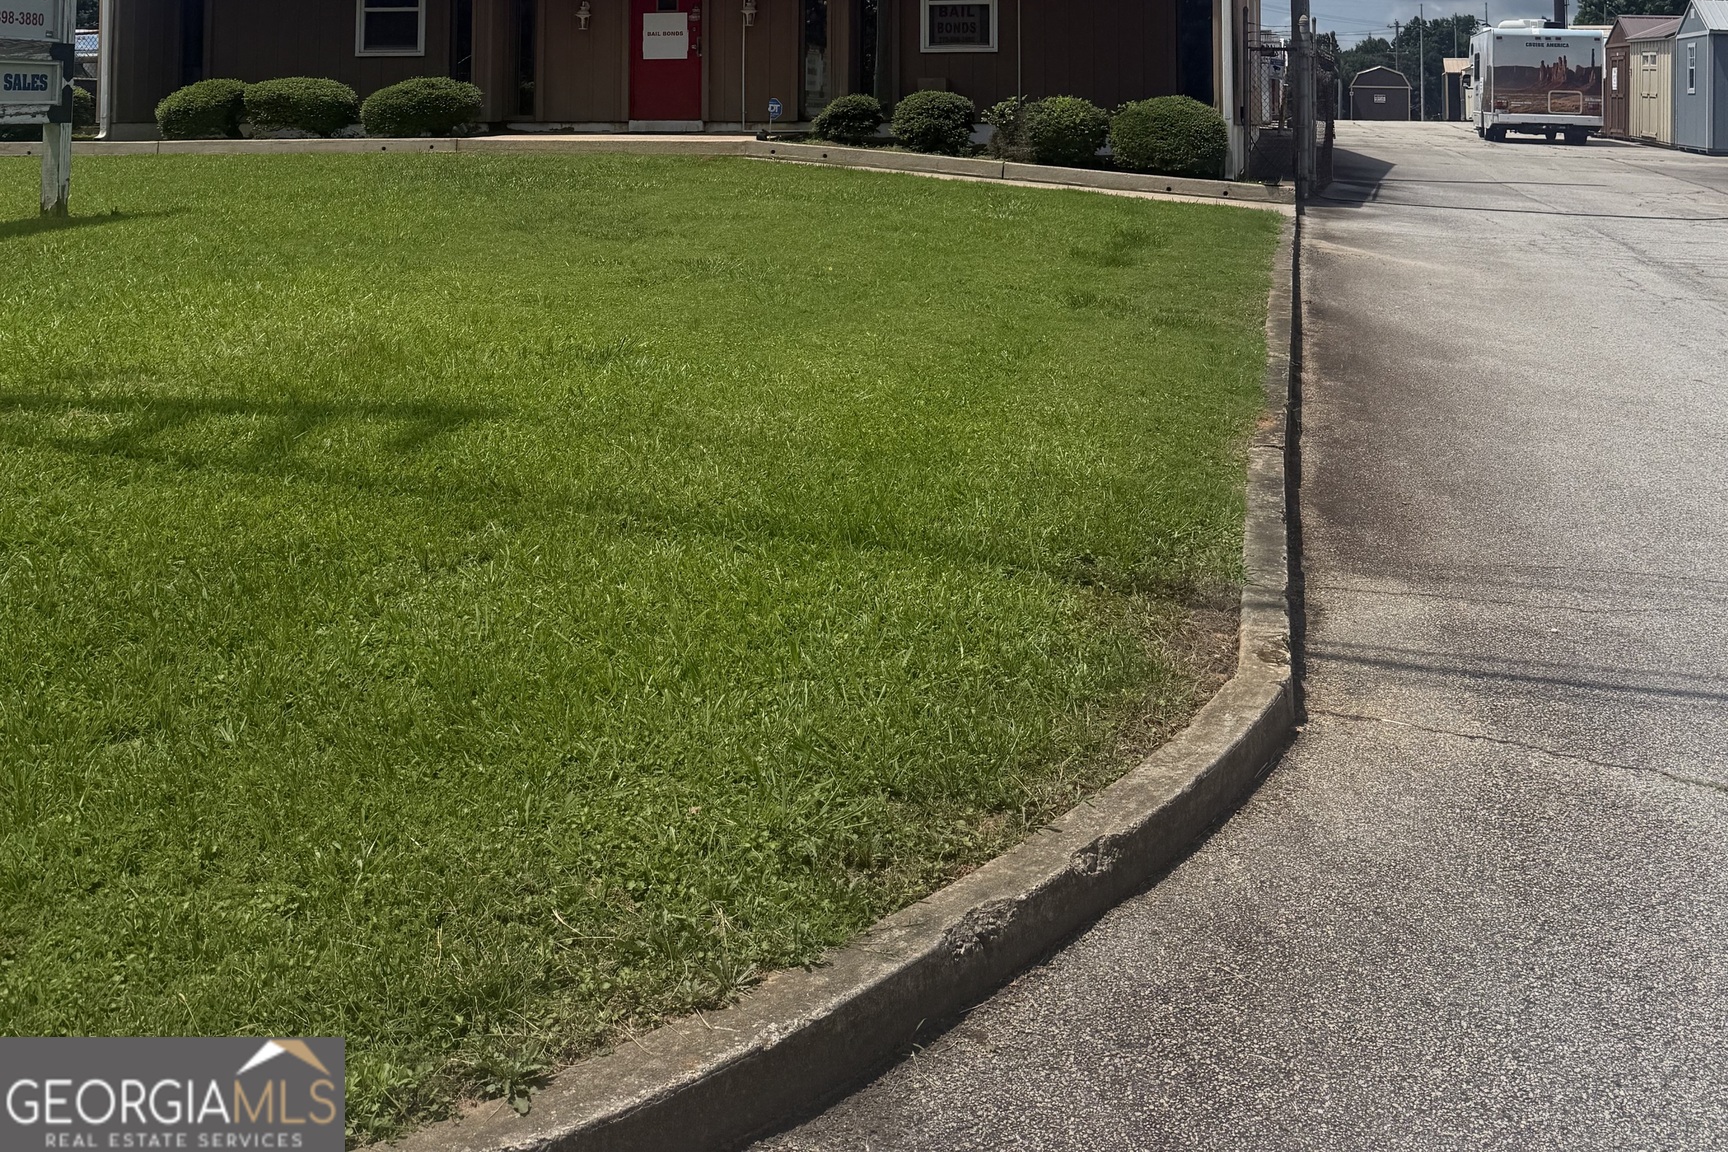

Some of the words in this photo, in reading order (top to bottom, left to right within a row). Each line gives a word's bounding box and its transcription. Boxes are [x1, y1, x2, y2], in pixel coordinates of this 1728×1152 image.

[0, 10, 45, 27] 98-3880
[938, 6, 975, 18] BAIL
[937, 22, 977, 34] BONDS
[3, 73, 48, 92] SALES
